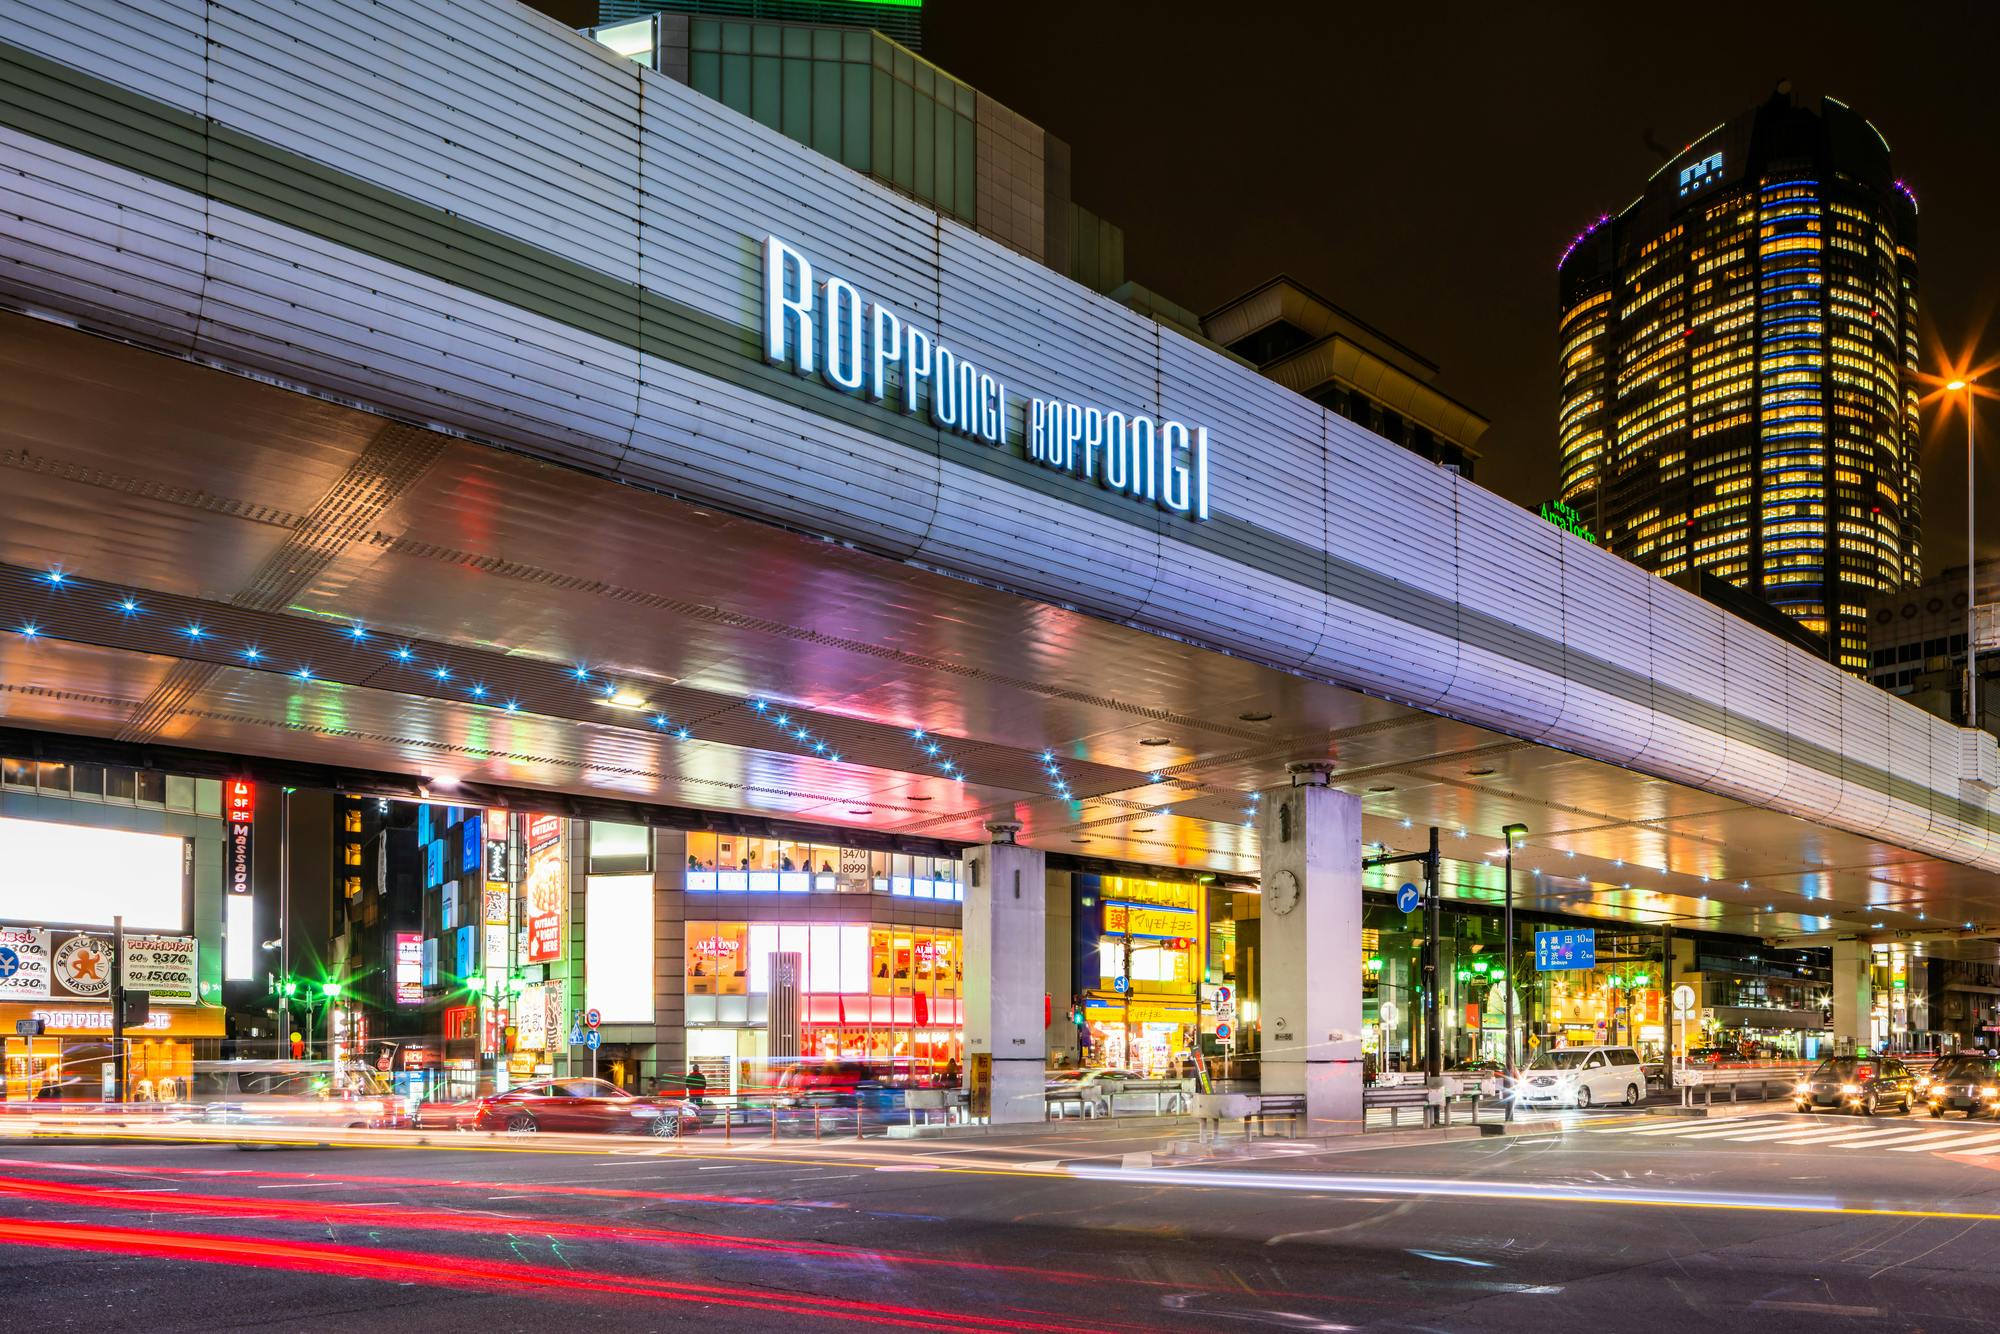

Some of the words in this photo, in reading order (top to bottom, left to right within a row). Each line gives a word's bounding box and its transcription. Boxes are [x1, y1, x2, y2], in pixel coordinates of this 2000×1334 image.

[764, 235, 1006, 446] ROPPONGI
[1028, 398, 1208, 520] ROPPONGI
[1554, 500, 1580, 521] HOTEL
[234, 798, 249, 808] 3F
[232, 811, 249, 821] 2F
[233, 824, 248, 893] Massage
[842, 849, 867, 859] 3470
[842, 863, 867, 874] 8999
[1135, 913, 1193, 934] マツモトキヨシ
[1551, 951, 1573, 960] 渋谷
[65, 978, 110, 992] MASSAGE
